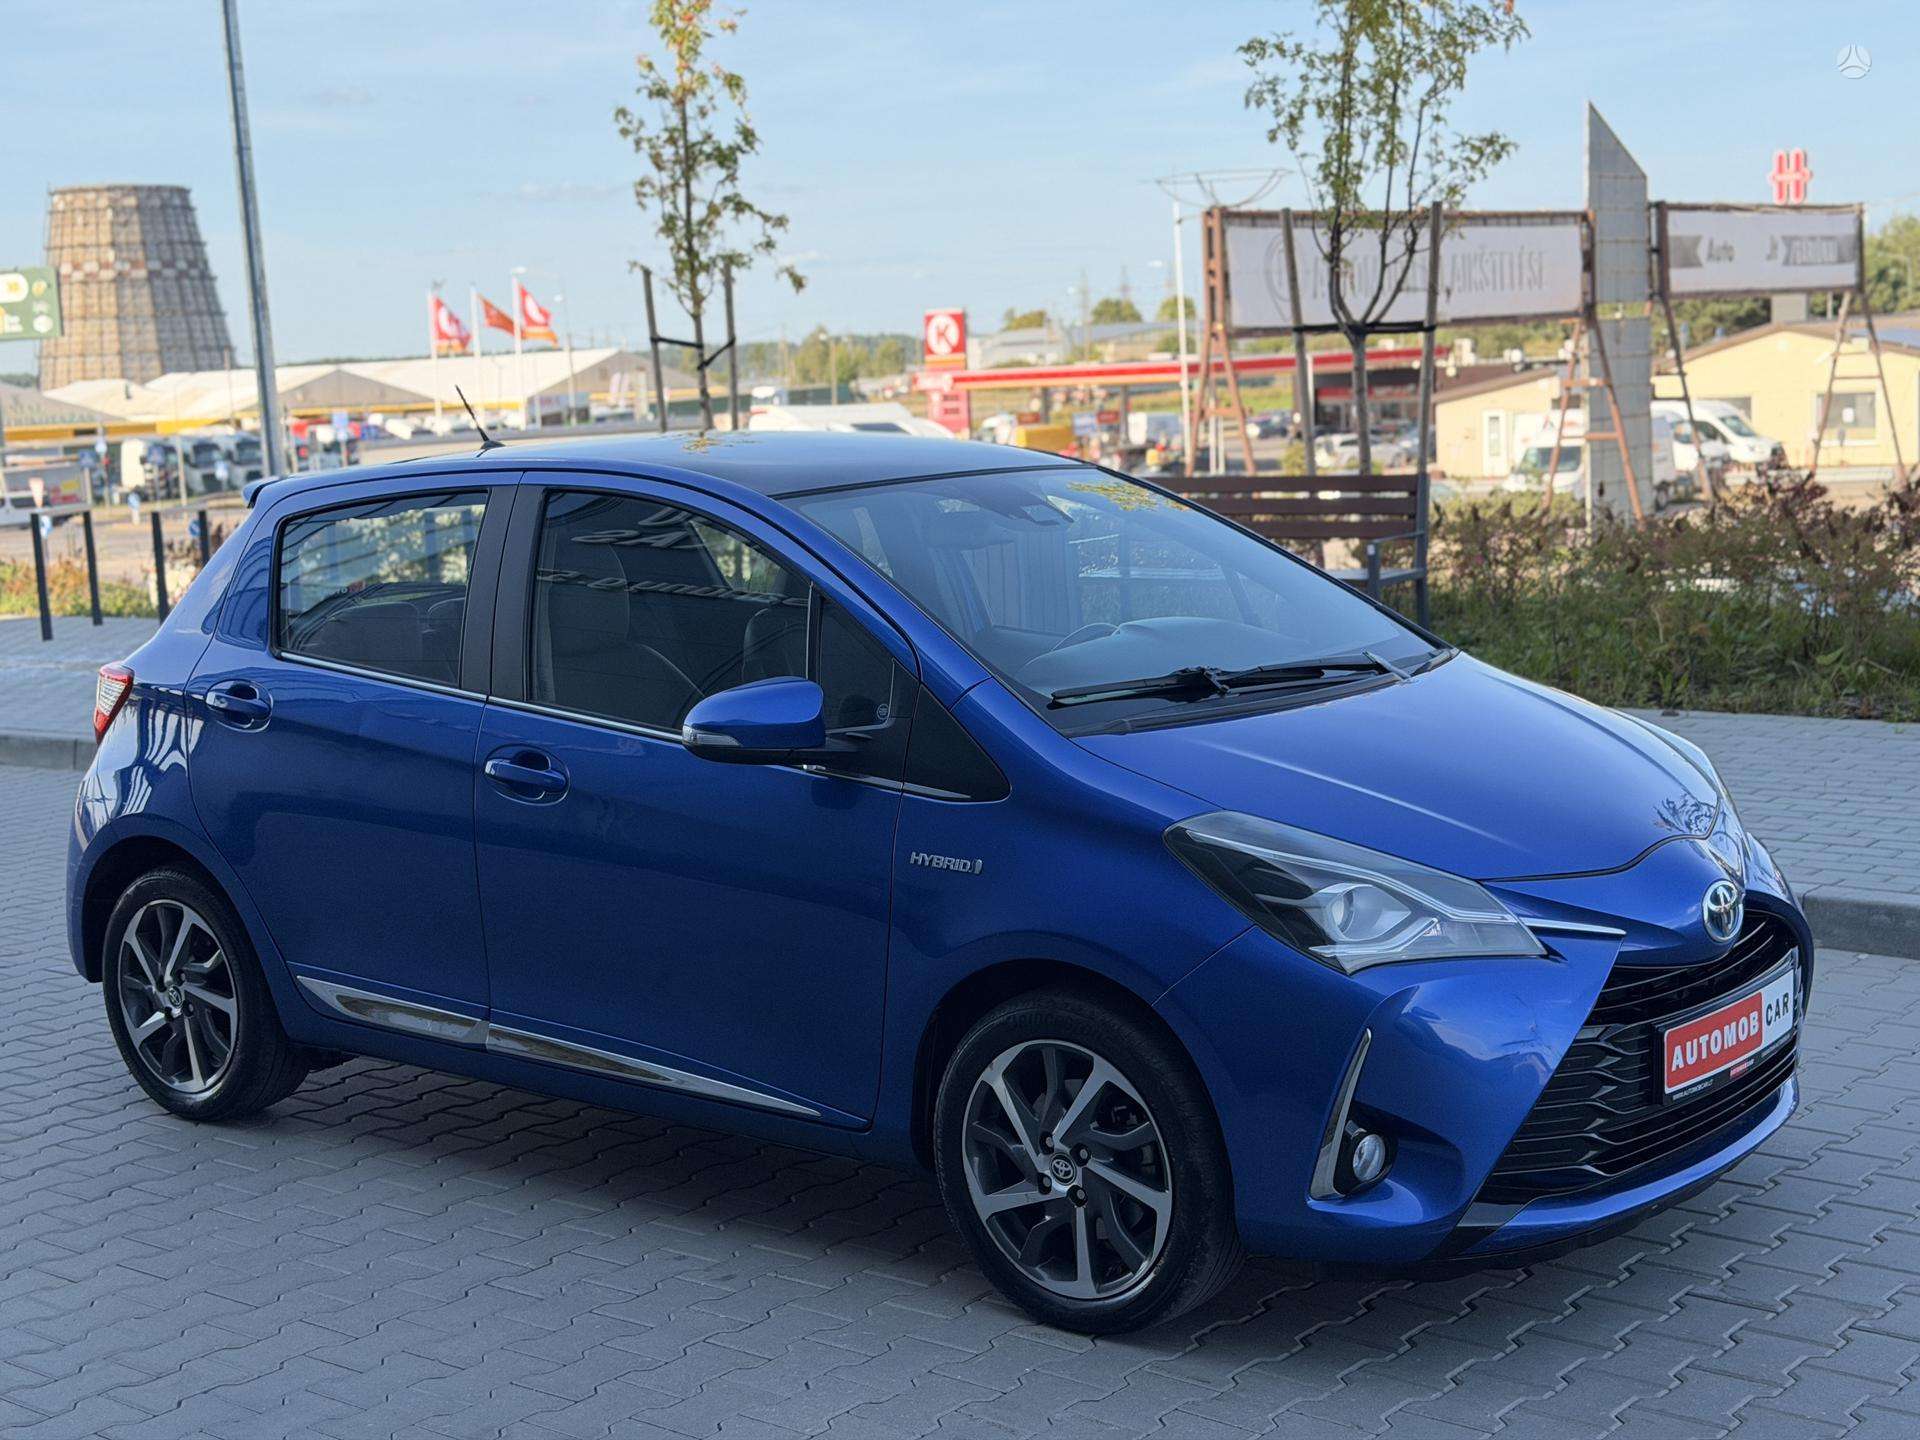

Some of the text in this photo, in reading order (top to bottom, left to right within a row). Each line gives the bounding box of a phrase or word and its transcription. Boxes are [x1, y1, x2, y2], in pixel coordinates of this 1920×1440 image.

[909, 850, 971, 873] HYBRID
[1671, 1011, 1759, 1072] AUTOMOB
[1765, 992, 1789, 1027] CAR
